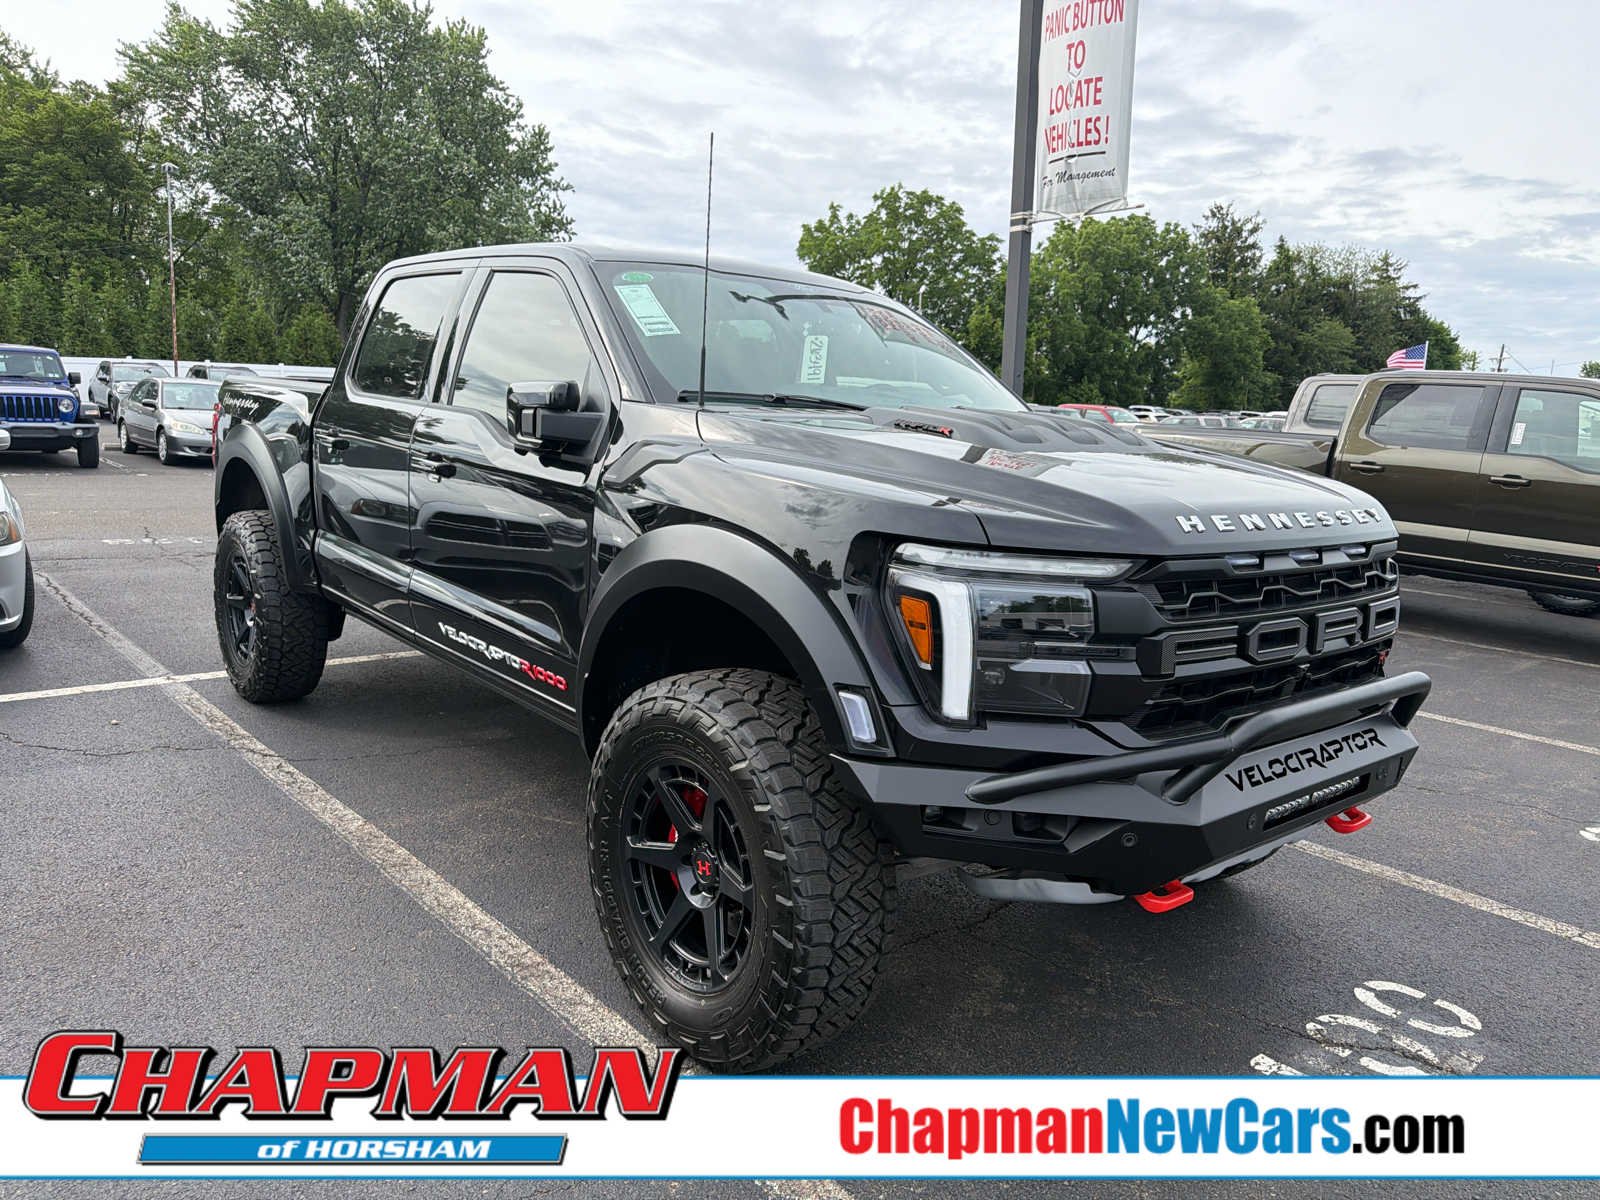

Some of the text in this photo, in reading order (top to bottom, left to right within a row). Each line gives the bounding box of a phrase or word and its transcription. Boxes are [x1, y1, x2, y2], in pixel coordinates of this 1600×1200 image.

[1045, 0, 1125, 43] PANIC BUTTON
[1066, 39, 1087, 72] TO
[1049, 76, 1104, 116] LOCATE
[1175, 508, 1382, 534] HENNESSEY
[1143, 595, 1400, 679] FORD
[1225, 728, 1387, 792] VELOCIRAPTOR
